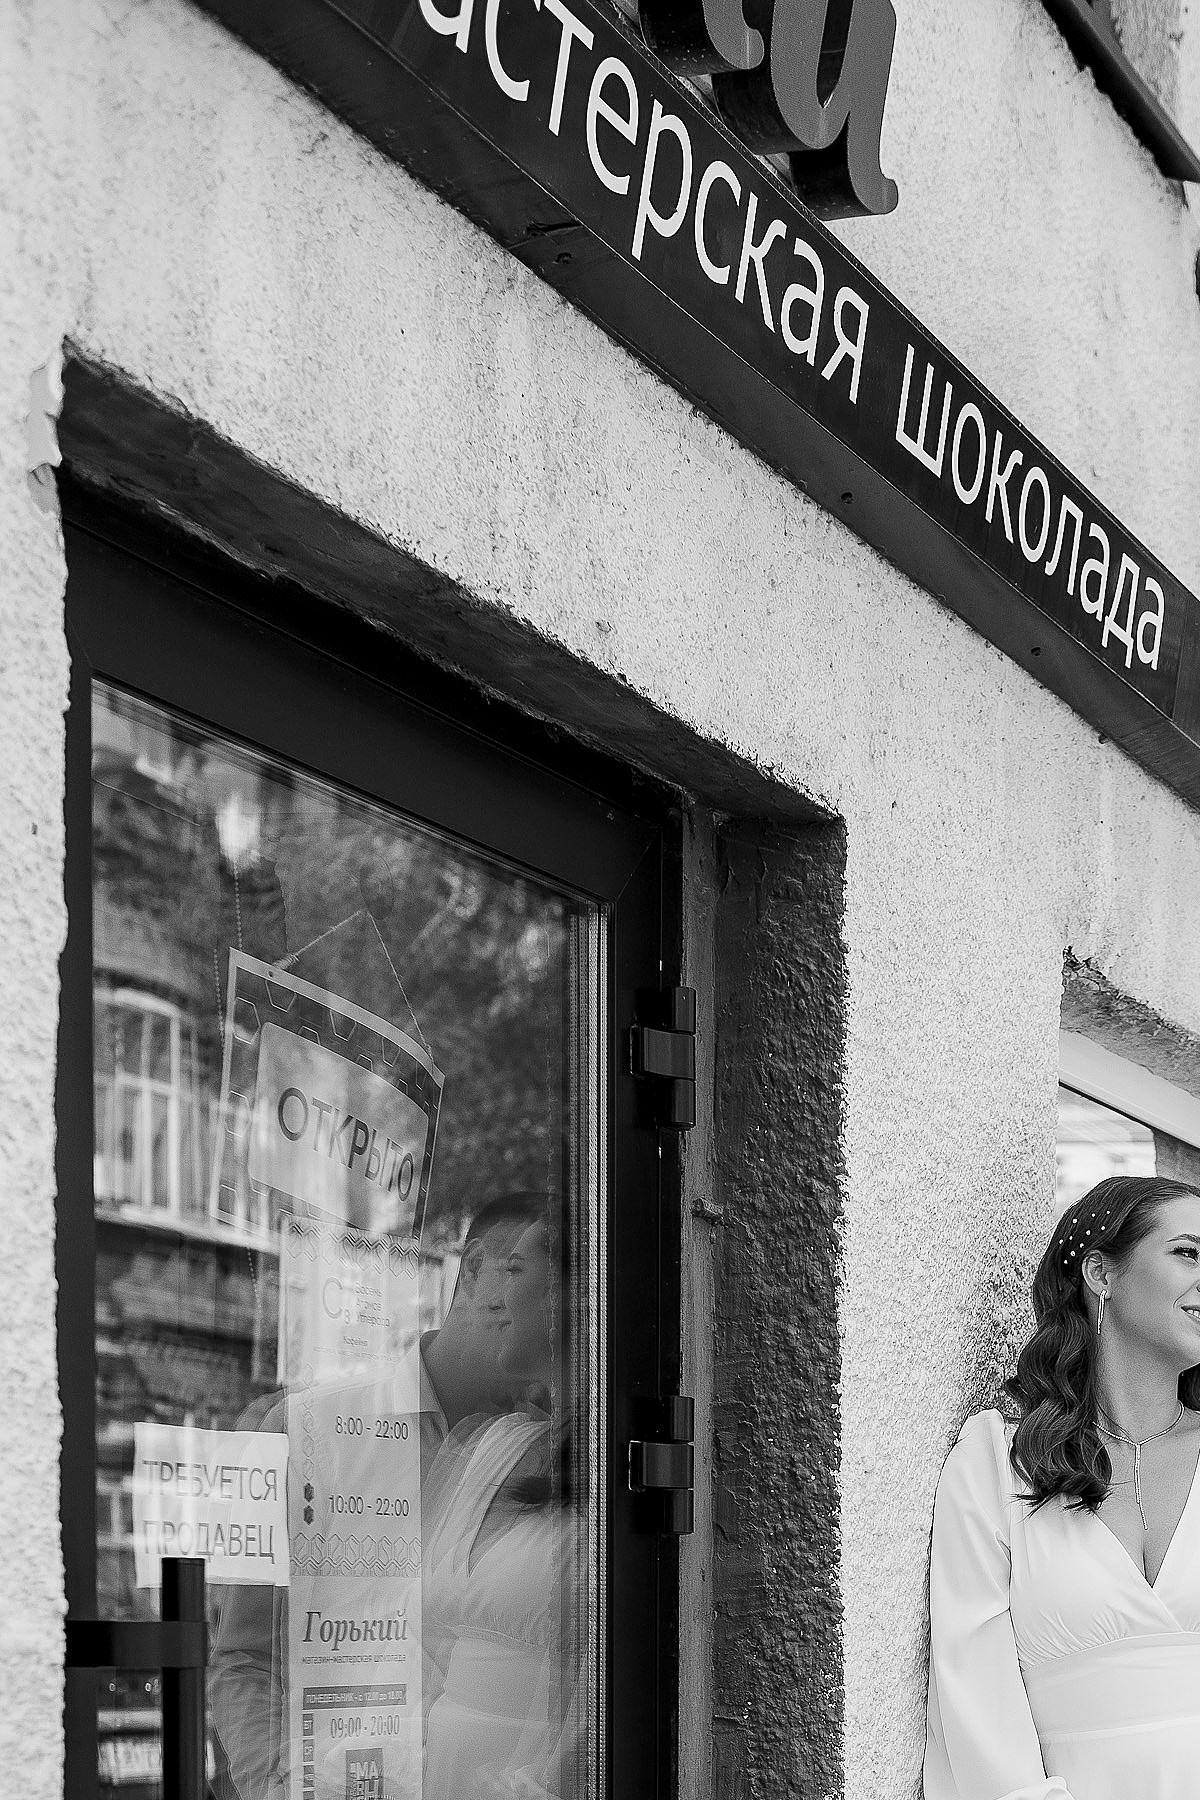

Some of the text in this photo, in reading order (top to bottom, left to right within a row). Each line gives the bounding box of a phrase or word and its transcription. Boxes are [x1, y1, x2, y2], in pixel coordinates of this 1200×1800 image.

[896, 344, 1165, 670] шоколада
[278, 1087, 414, 1202] ОТКРЫТО
[335, 1415, 363, 1435] 8:00
[375, 1419, 409, 1440] 22:00
[142, 1461, 278, 1501] ТРЕБУЕТСЯ
[329, 1495, 364, 1514] 10:00
[375, 1497, 410, 1517] 22:00
[143, 1520, 275, 1564] ПРОДАВЕЦ
[302, 1609, 408, 1651] Горький
[330, 1717, 361, 1738] 09:00
[370, 1714, 400, 1736] 20:00
